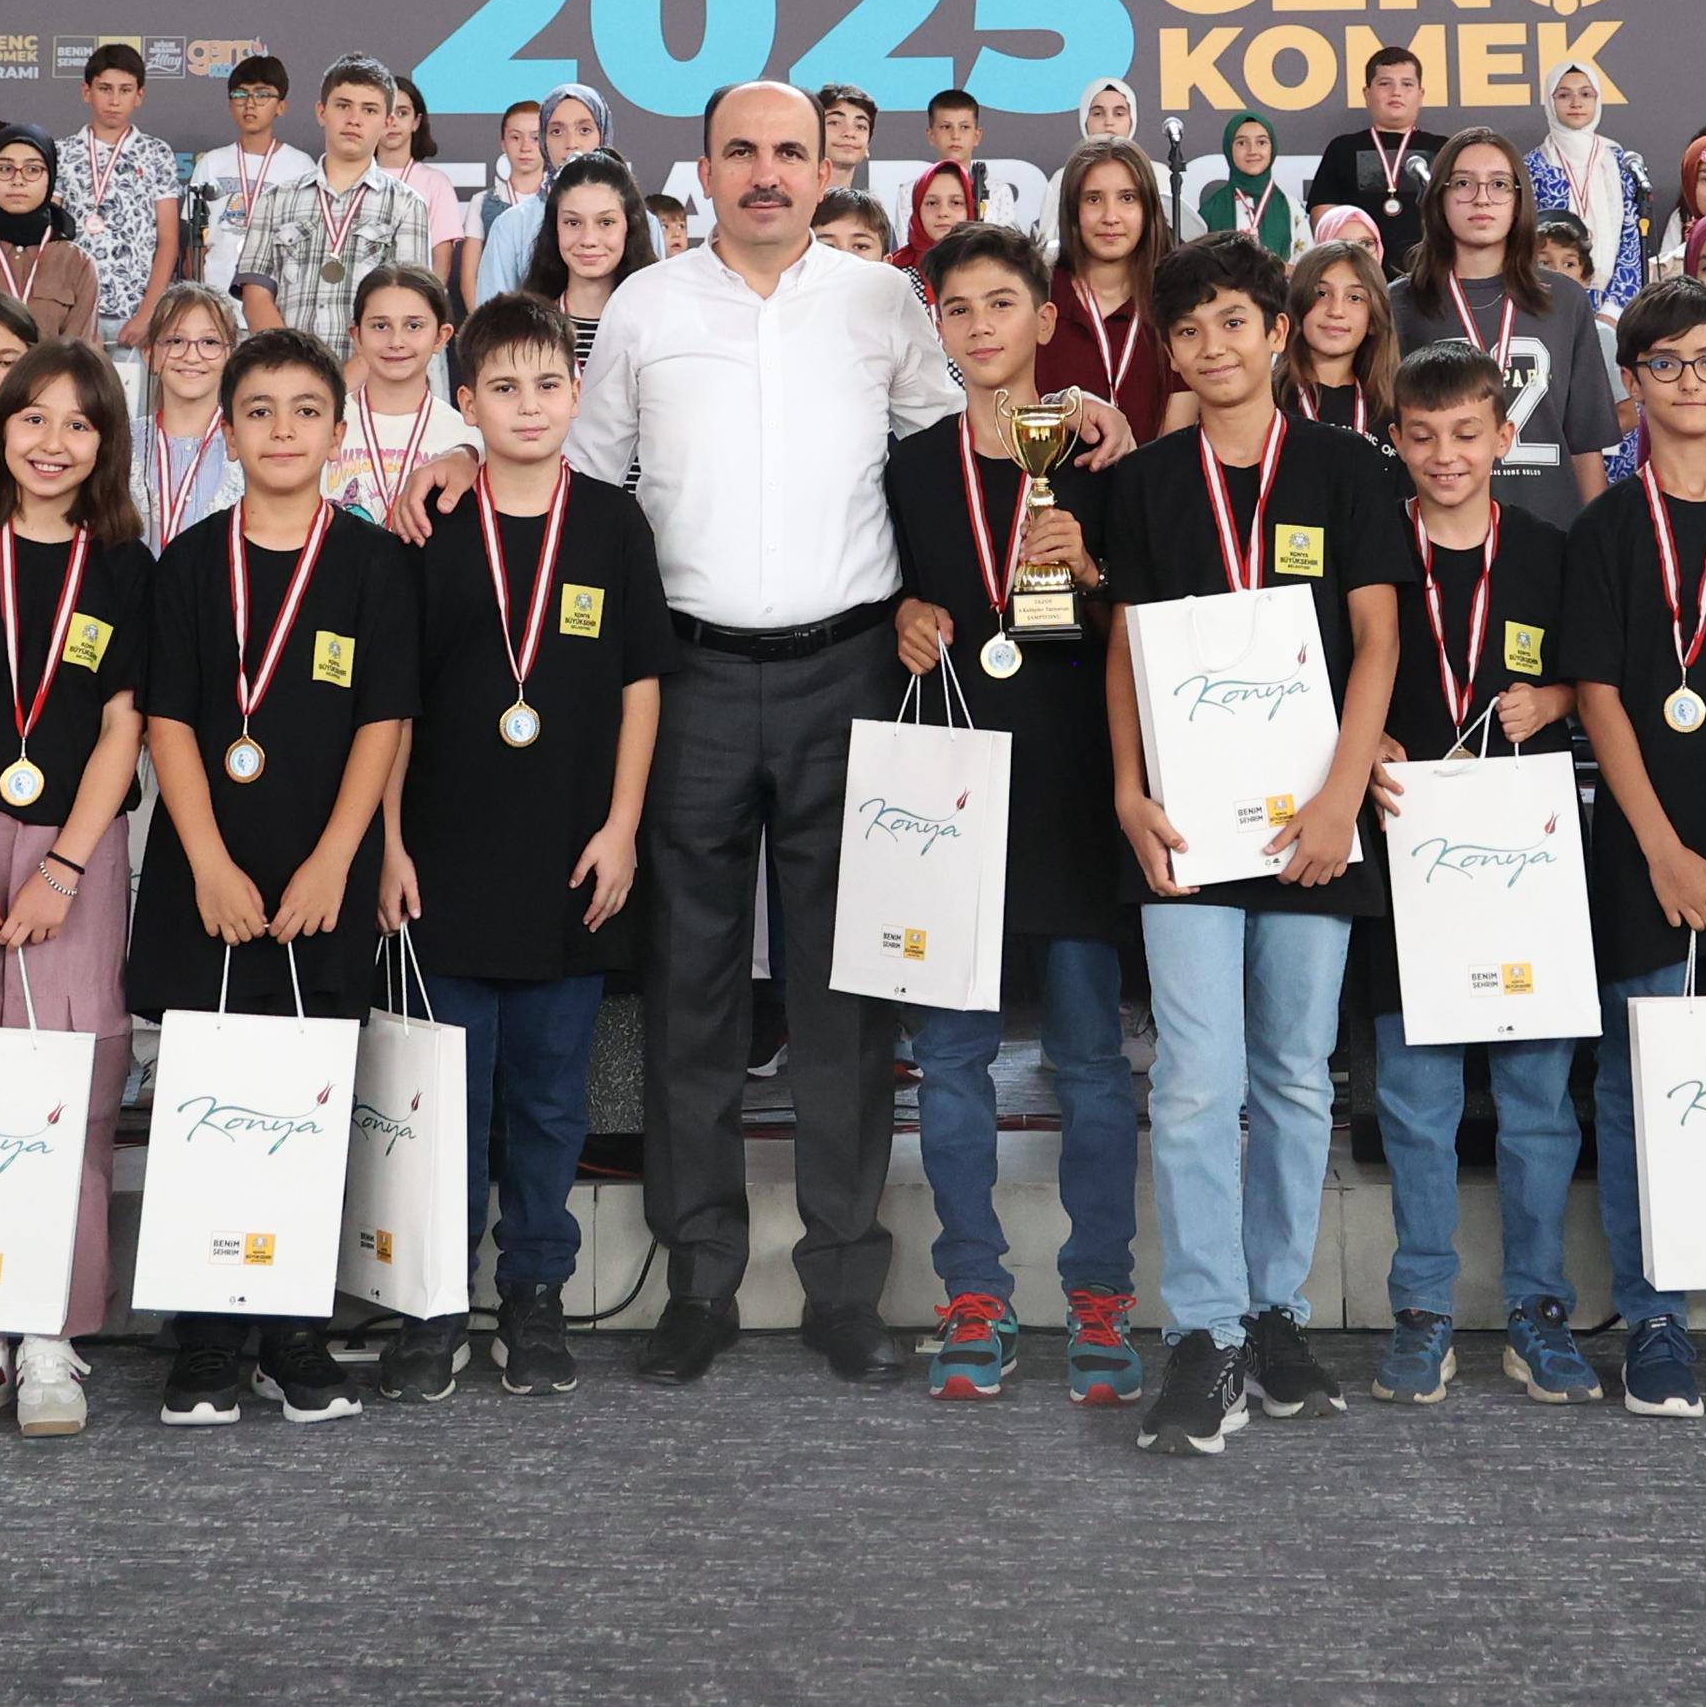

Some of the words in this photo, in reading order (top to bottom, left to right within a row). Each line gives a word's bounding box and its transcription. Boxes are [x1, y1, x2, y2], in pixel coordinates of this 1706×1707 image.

[1160, 20, 1629, 112] KOMEK
[1173, 676, 1310, 721] Konya
[860, 799, 961, 856] Konya
[1410, 838, 1558, 888] Konya
[177, 1097, 324, 1154] Konya
